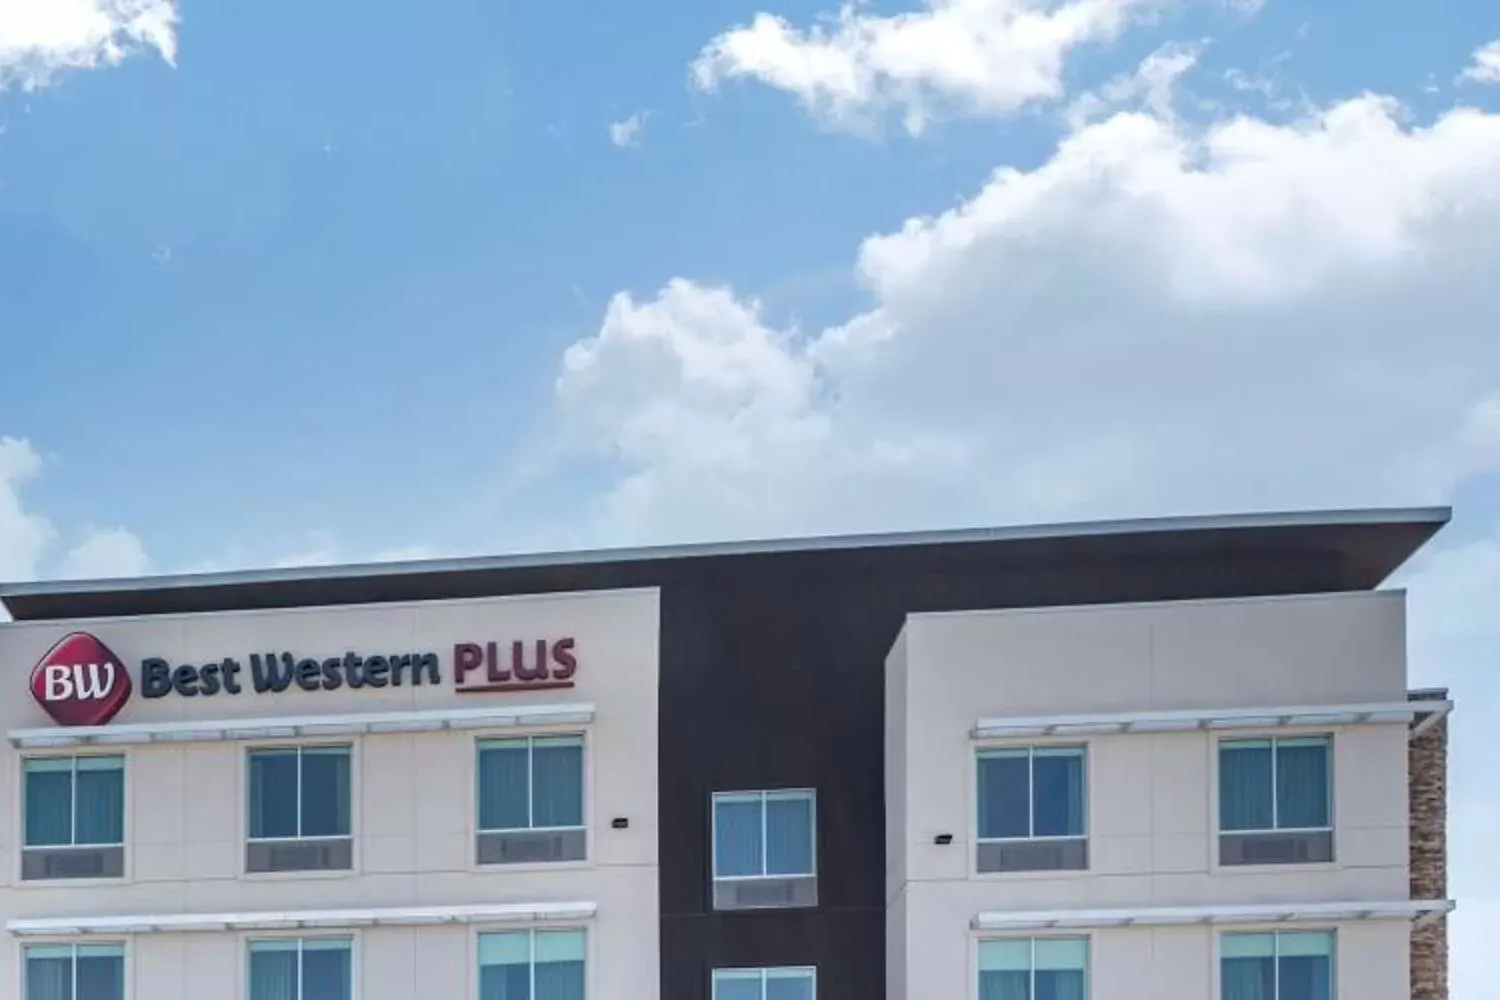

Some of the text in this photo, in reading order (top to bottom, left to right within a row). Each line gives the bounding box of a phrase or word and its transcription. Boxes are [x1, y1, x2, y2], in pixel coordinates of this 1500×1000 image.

[45, 662, 115, 700] BW
[141, 637, 577, 698] Best Western PLUS
